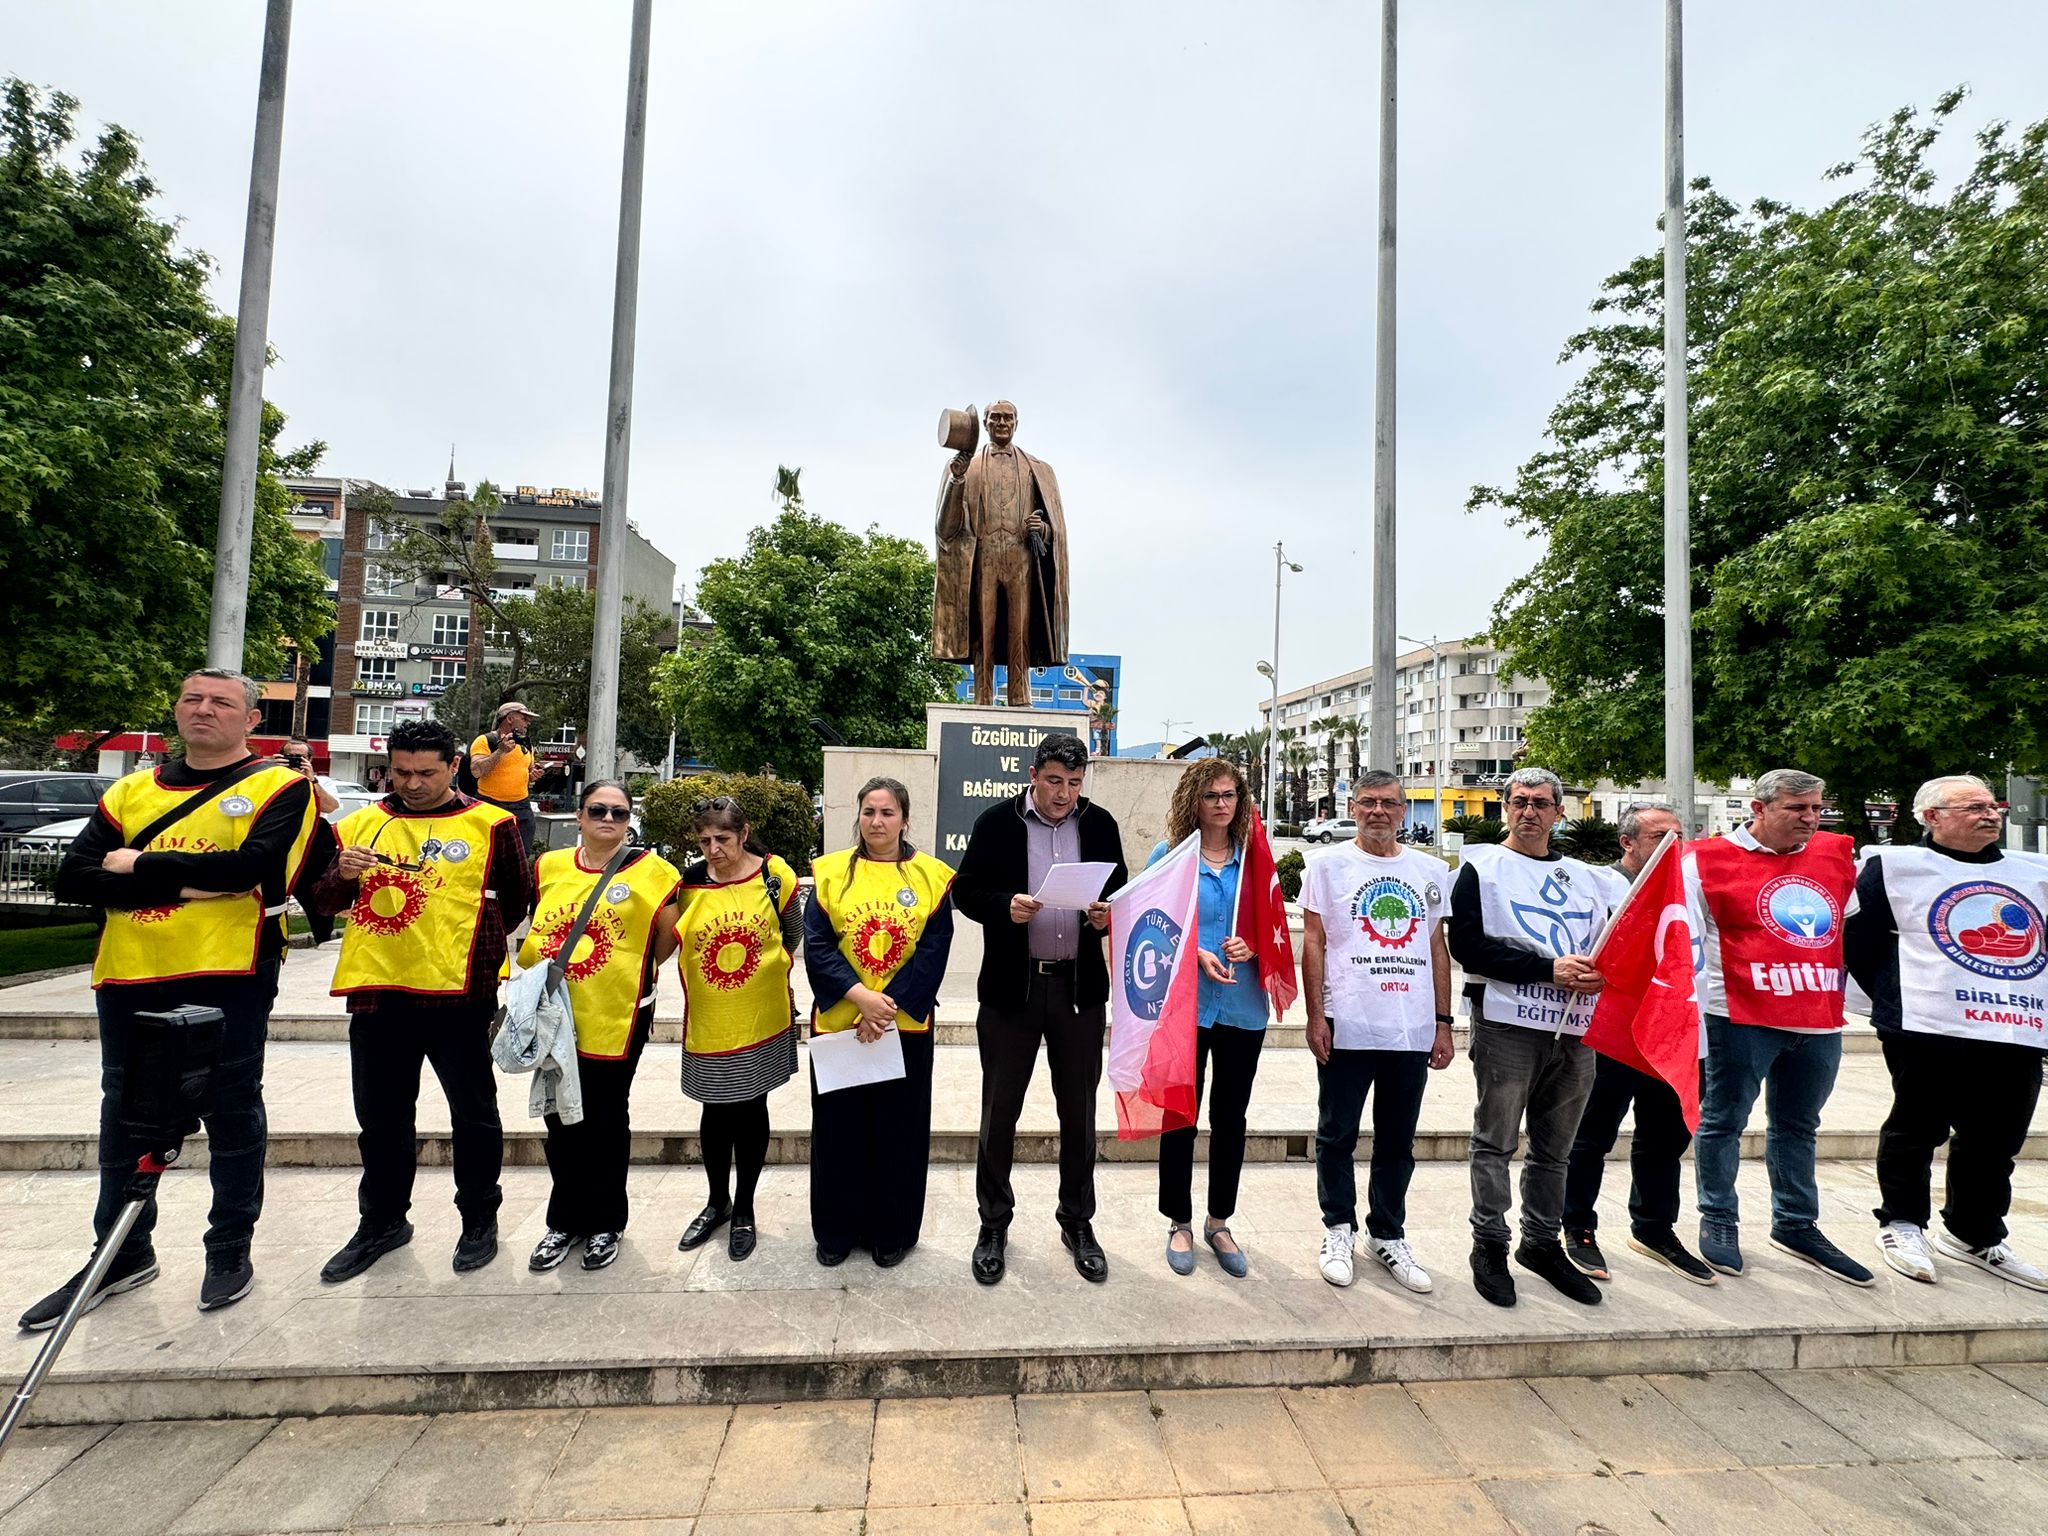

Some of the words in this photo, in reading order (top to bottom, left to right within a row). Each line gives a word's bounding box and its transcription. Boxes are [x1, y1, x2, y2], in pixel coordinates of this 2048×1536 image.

[1000, 756, 1020, 773] VE
[1354, 876, 1401, 902] EMEKLİLERİN
[1402, 882, 1426, 921] SENDİKASI
[602, 908, 627, 941] SEN
[694, 910, 744, 953] EĞİTİM
[1145, 911, 1171, 934] TÜRK
[1384, 930, 1402, 938] 2017
[1350, 955, 1371, 964] TÜM
[1375, 956, 1426, 967] EMEKLİLERİN
[1370, 967, 1415, 976] SENDİKASI
[1946, 946, 2004, 976] BİRLEŞİK
[2008, 954, 2046, 977] KAMU-İŞ
[1955, 987, 2044, 1011] BİRLEŞİK
[1965, 1009, 2043, 1033] KAMU-İŞ
